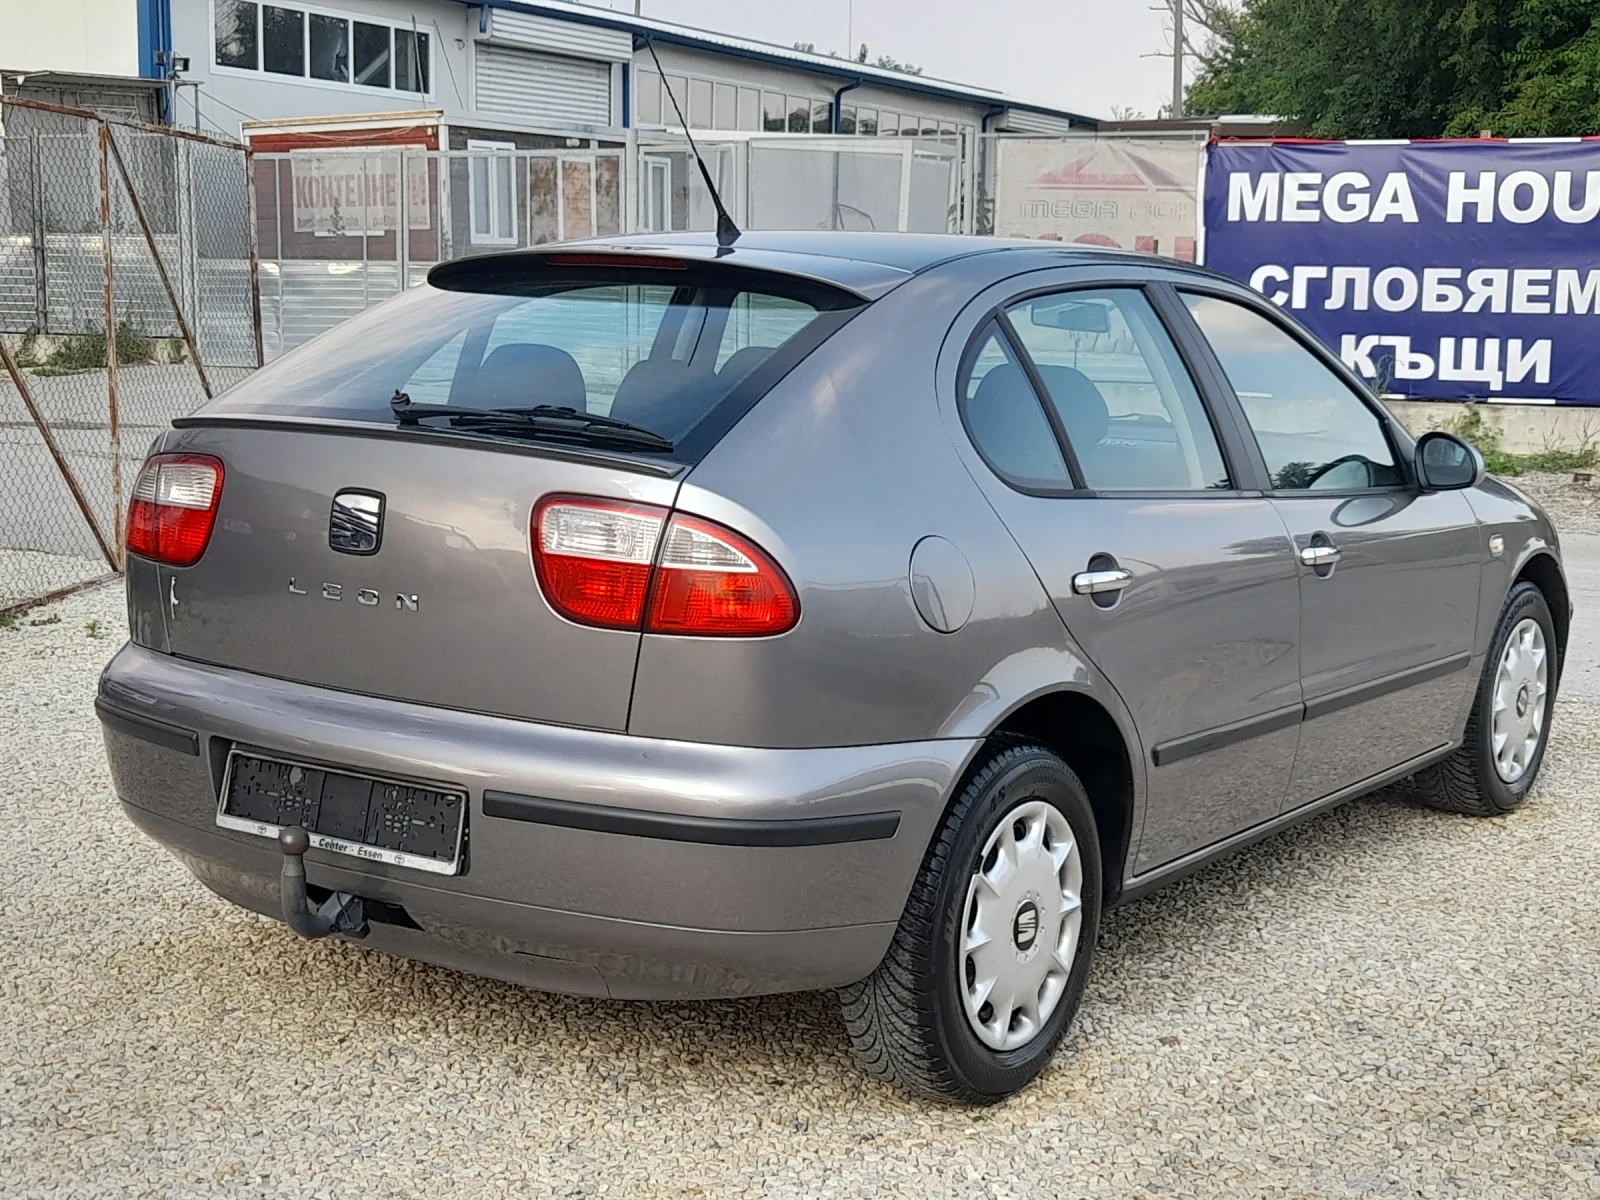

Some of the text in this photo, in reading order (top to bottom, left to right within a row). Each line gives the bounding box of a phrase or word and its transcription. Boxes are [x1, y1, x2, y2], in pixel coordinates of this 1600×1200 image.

[295, 172, 426, 209] КОНТЕЙНЕИ
[1226, 170, 1600, 224] MEGA HOU
[1020, 200, 1119, 219] MEGA
[1250, 264, 1600, 315] СГЛОБЯЕМ
[1340, 334, 1552, 391] КЪЩИ
[289, 576, 420, 612] LEON
[318, 838, 383, 860] Center Essen
